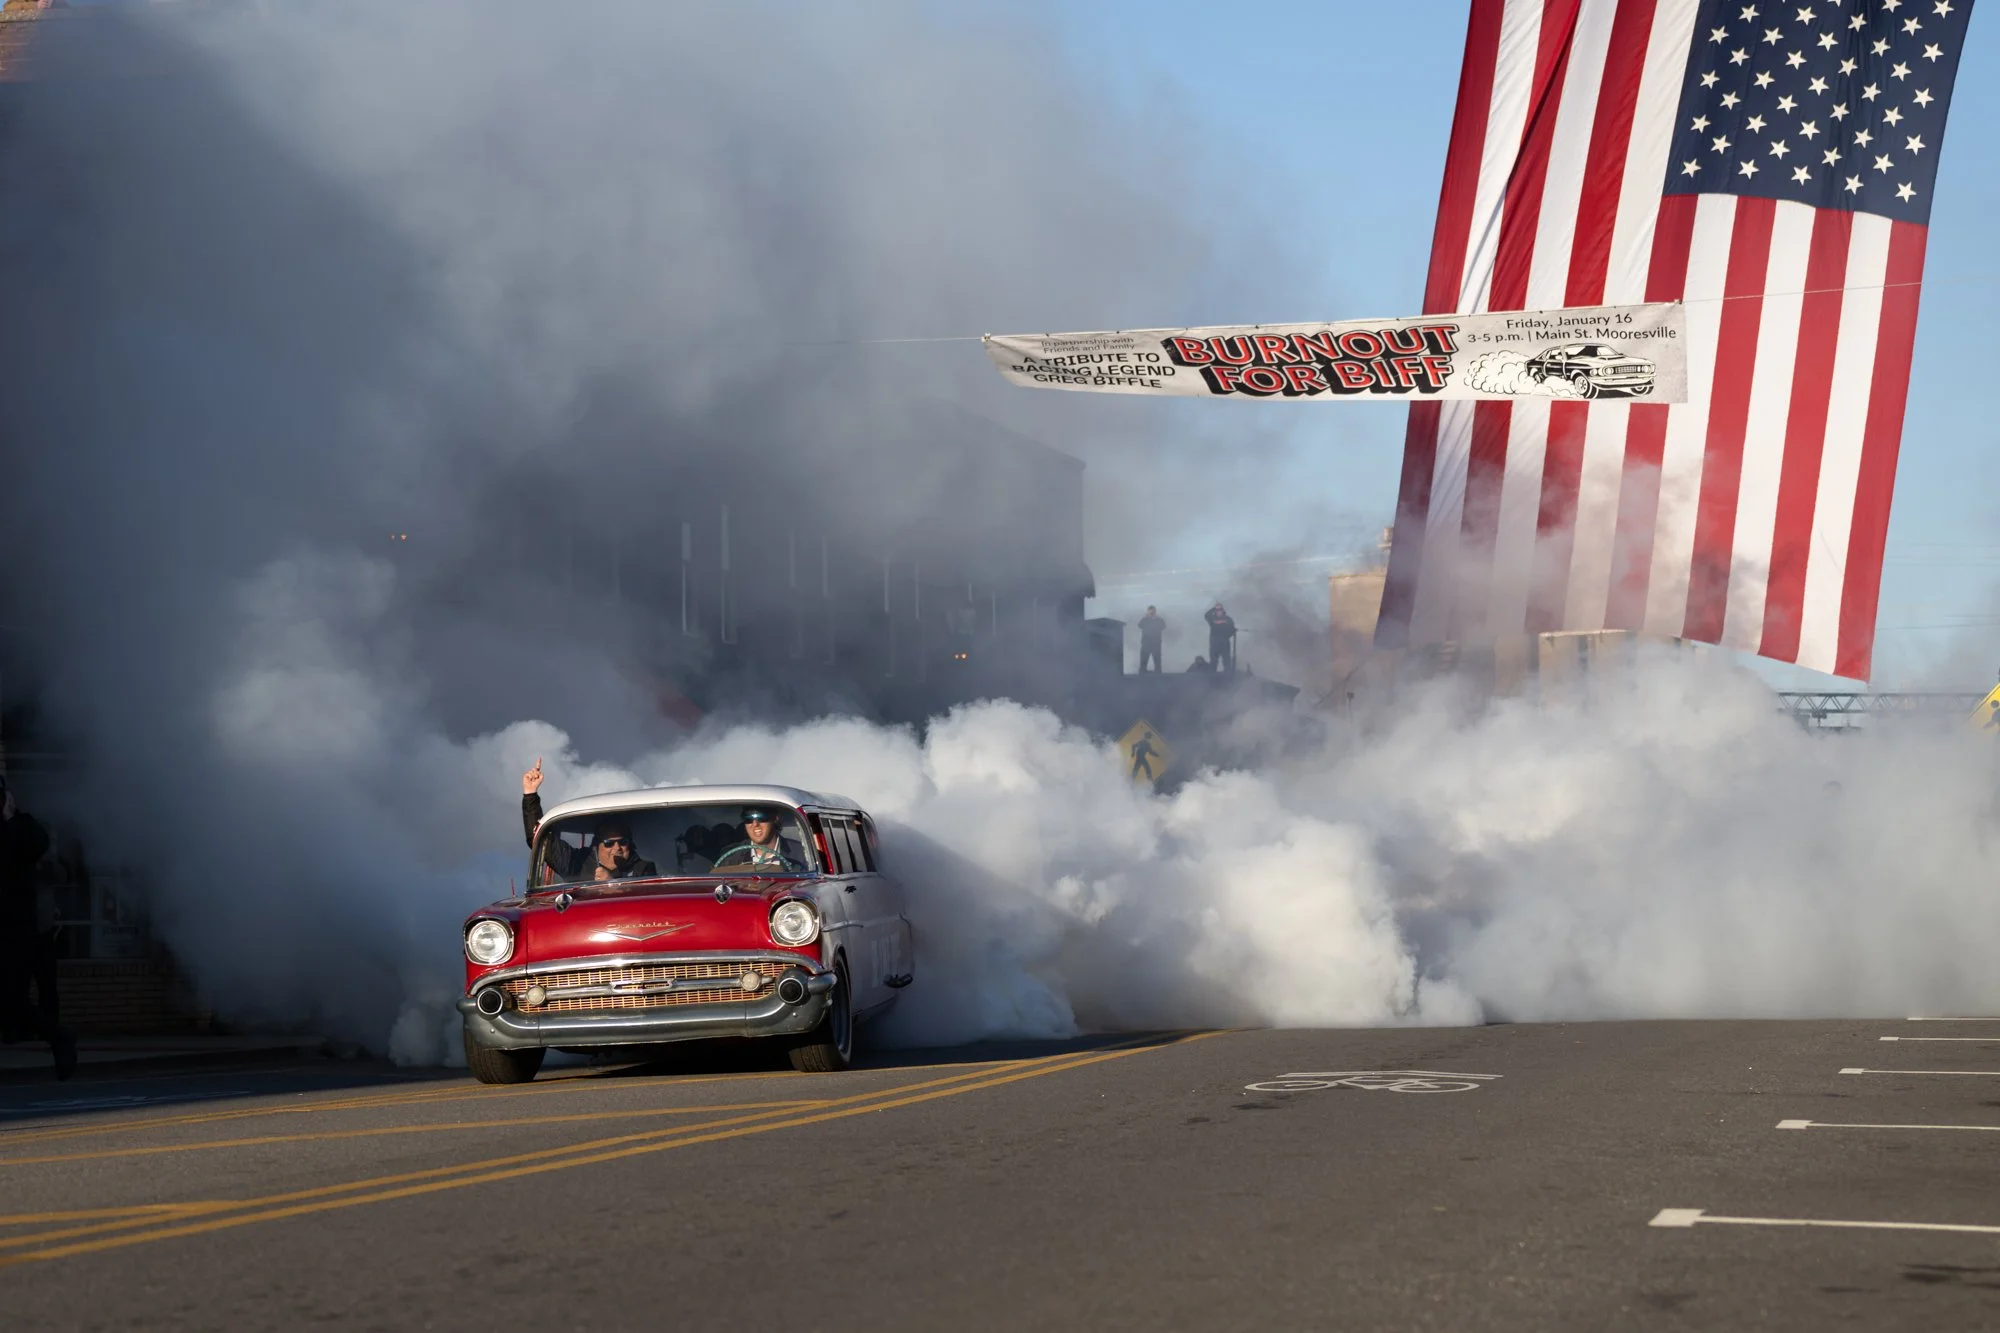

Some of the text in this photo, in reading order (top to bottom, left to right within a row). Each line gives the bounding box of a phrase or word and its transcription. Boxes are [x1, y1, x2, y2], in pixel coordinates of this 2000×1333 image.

[1506, 313, 1633, 329] Friday, January 16
[1467, 333, 1491, 343] 3-5
[1495, 333, 1524, 344] p.m.
[1536, 329, 1571, 340] Main
[1574, 328, 1592, 339] St.
[1596, 326, 1677, 340] Mooresville
[1043, 342, 1136, 354] Friends and Family
[1056, 339, 1109, 348] partnership
[1161, 324, 1459, 365] BURNOUT
[1023, 352, 1160, 366] A TRIBUTE TO
[1012, 364, 1176, 377] RACING LEGEND
[1200, 355, 1454, 396] FOR BIFF
[1033, 374, 1163, 388] GREG BIFFLE
